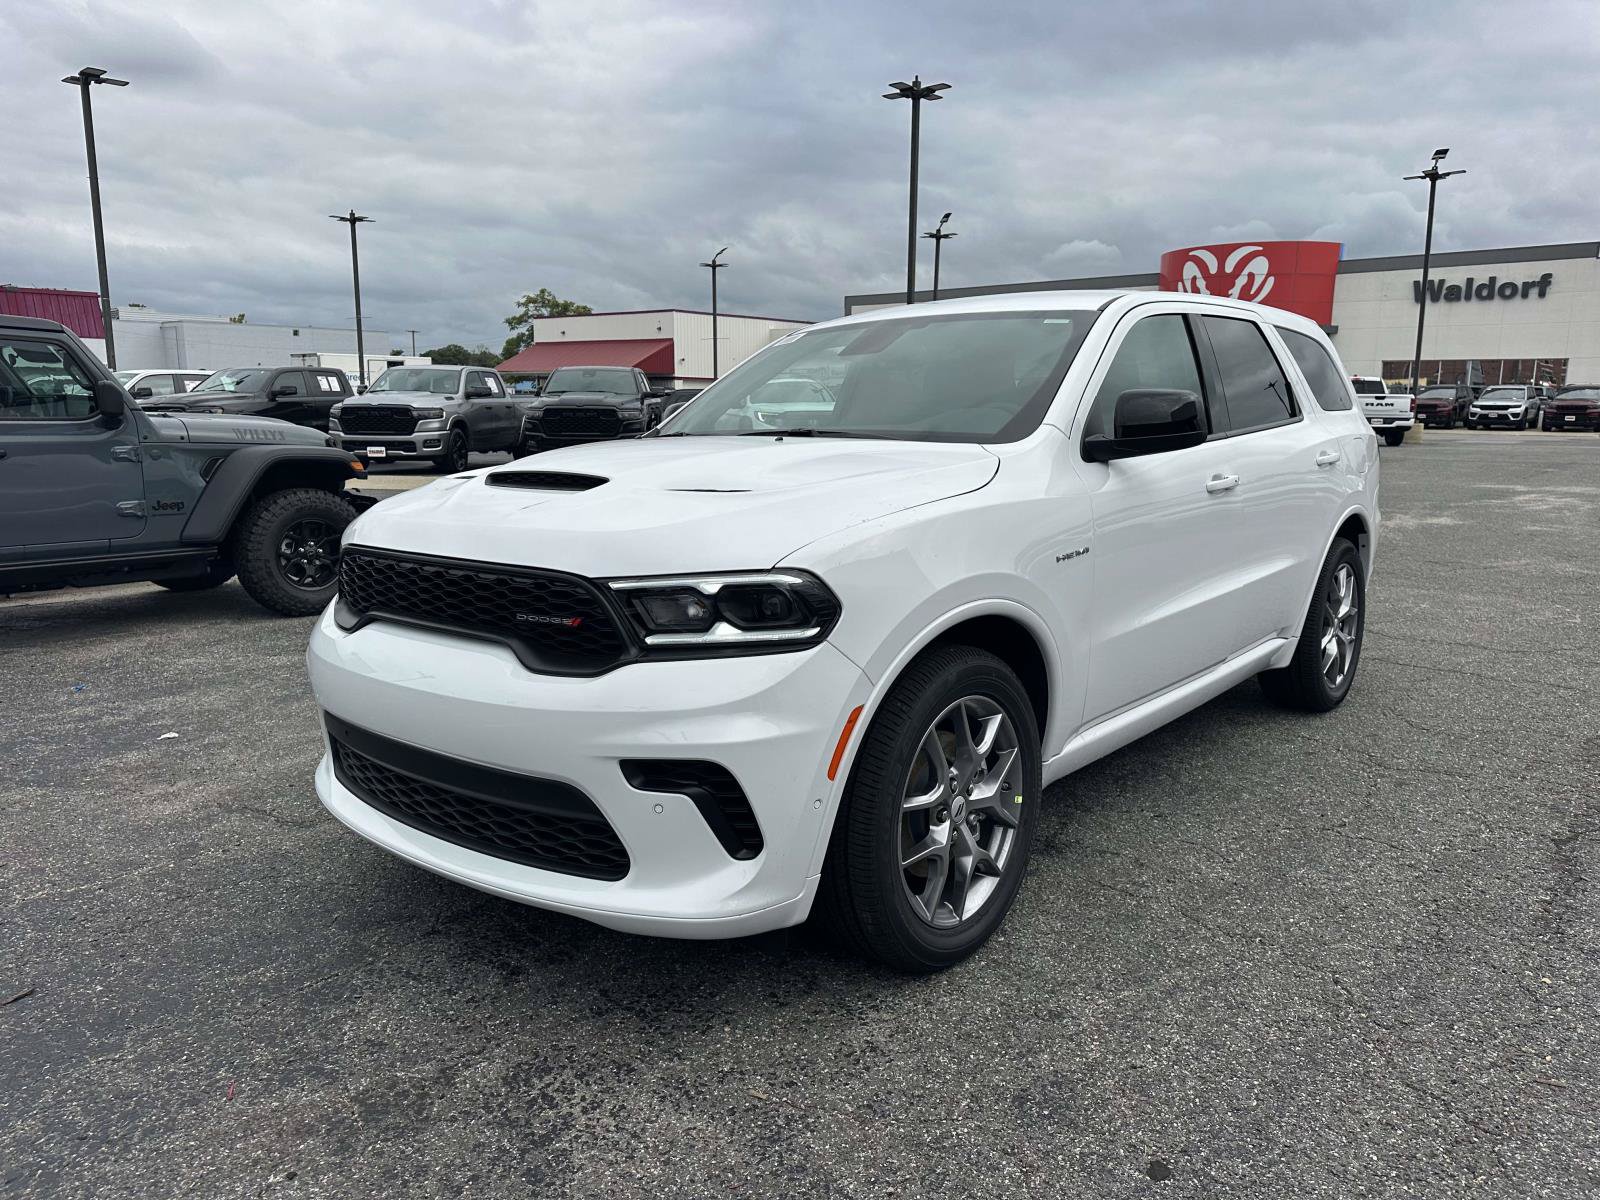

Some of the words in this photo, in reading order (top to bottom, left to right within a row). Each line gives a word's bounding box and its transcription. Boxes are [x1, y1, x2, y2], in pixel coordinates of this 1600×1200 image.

[1413, 273, 1553, 303] Waldorf
[231, 428, 286, 441] WILLYS
[151, 500, 185, 511] Jeep
[1055, 547, 1090, 563] HEMI
[516, 613, 573, 625] DODGE
